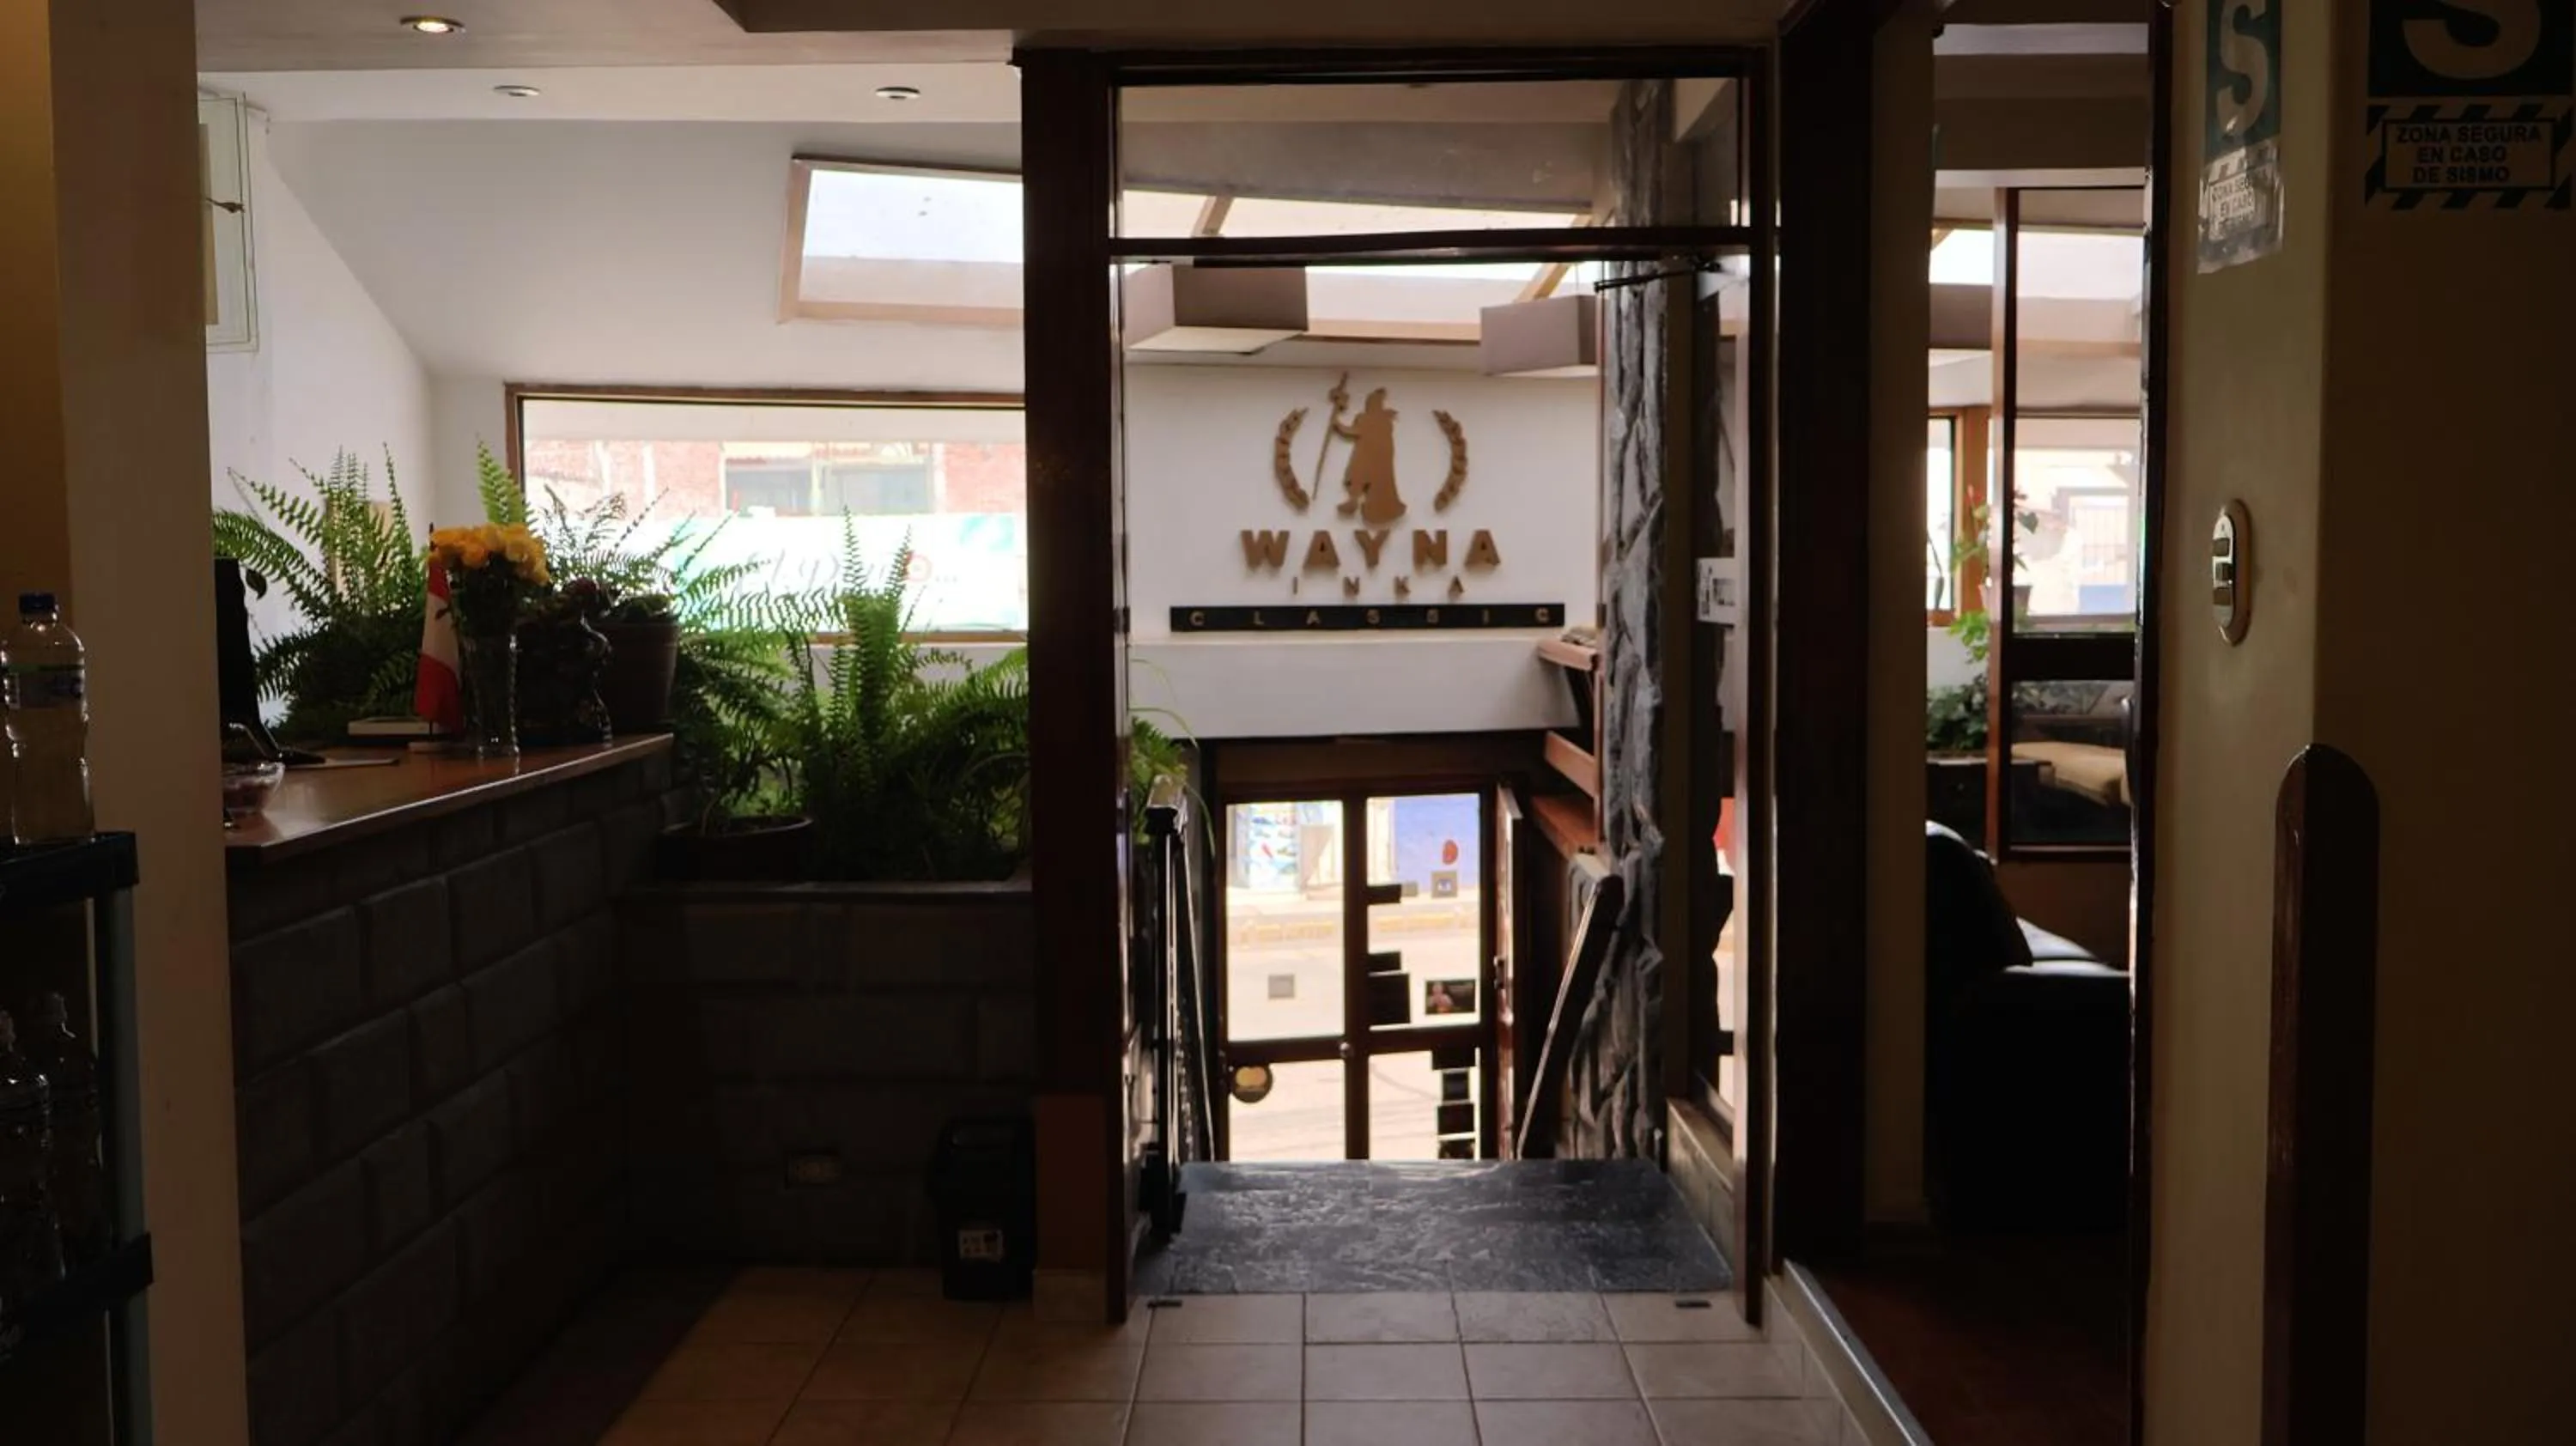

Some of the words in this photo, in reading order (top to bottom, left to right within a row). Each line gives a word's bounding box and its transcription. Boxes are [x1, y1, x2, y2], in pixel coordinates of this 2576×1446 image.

[2397, 127, 2451, 143] ZONA
[2458, 126, 2541, 143] SEGURA
[2417, 146, 2443, 162] EN
[2451, 146, 2506, 162] CASO
[2414, 167, 2439, 183] DE
[2446, 167, 2509, 183] SISMO
[1242, 530, 1500, 570] WAYNA
[1293, 576, 1464, 596] INKA
[1190, 608, 1549, 627] CLASSIC
